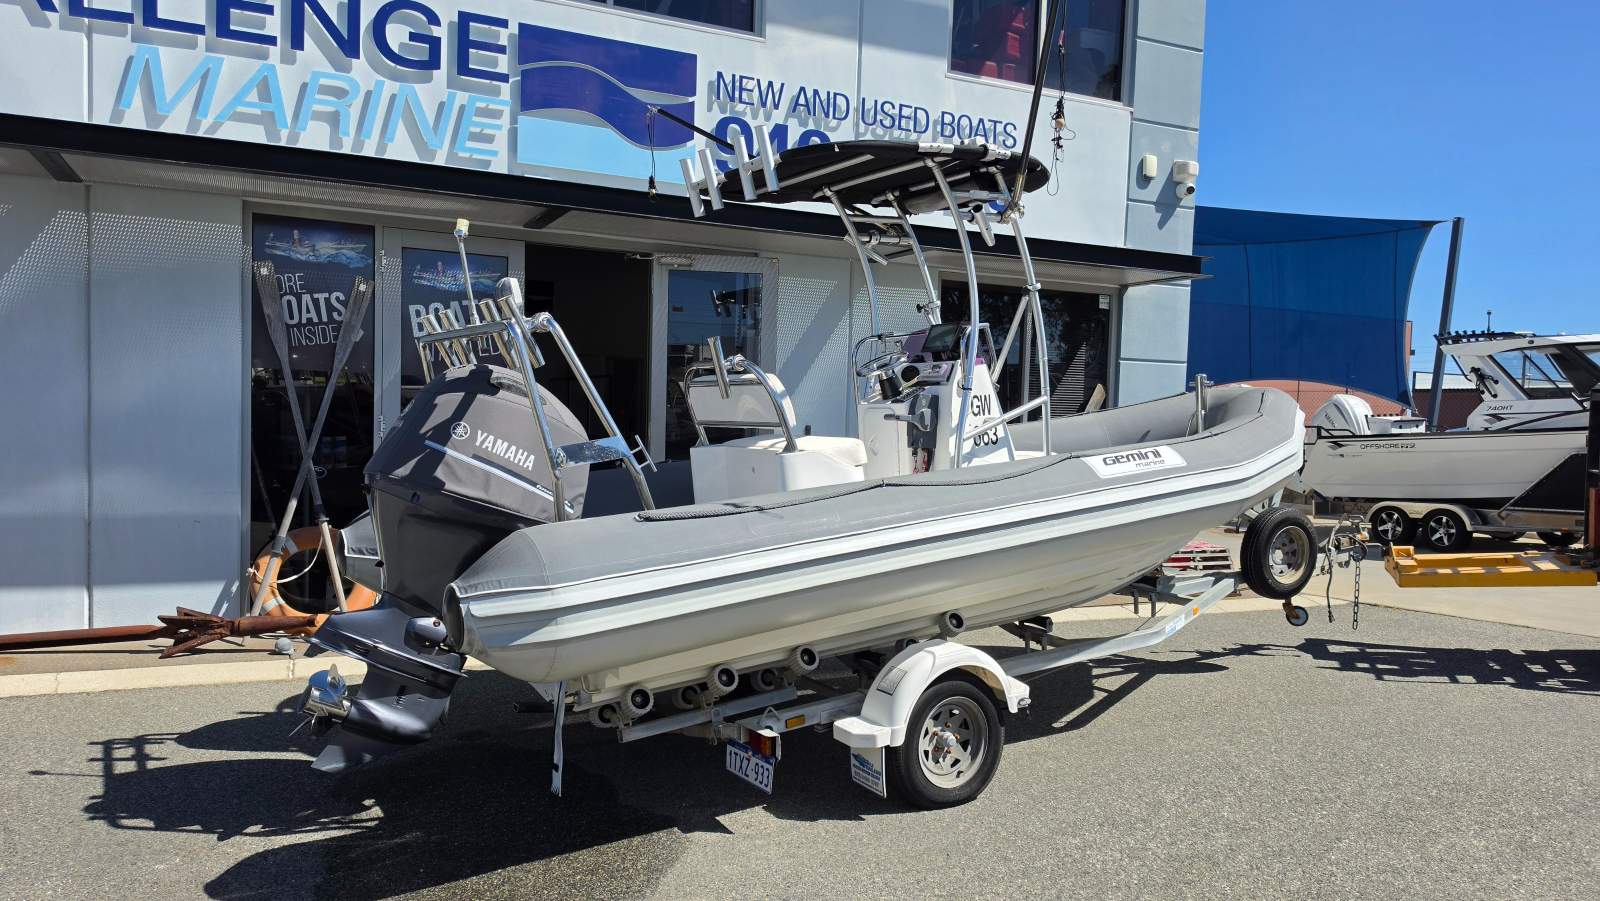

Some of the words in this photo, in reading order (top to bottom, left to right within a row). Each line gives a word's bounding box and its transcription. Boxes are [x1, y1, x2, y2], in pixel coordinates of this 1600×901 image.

[119, 44, 511, 158] MARINE
[716, 71, 785, 111] NEW
[791, 86, 850, 122] AND
[860, 97, 930, 134] USED
[940, 111, 1018, 149] BOATS
[275, 272, 307, 294] ORE
[281, 291, 346, 325] OATS
[290, 324, 338, 347] INSIDE
[970, 394, 991, 417] GW
[474, 429, 536, 471] YAMAHA
[1135, 459, 1166, 469] marine
